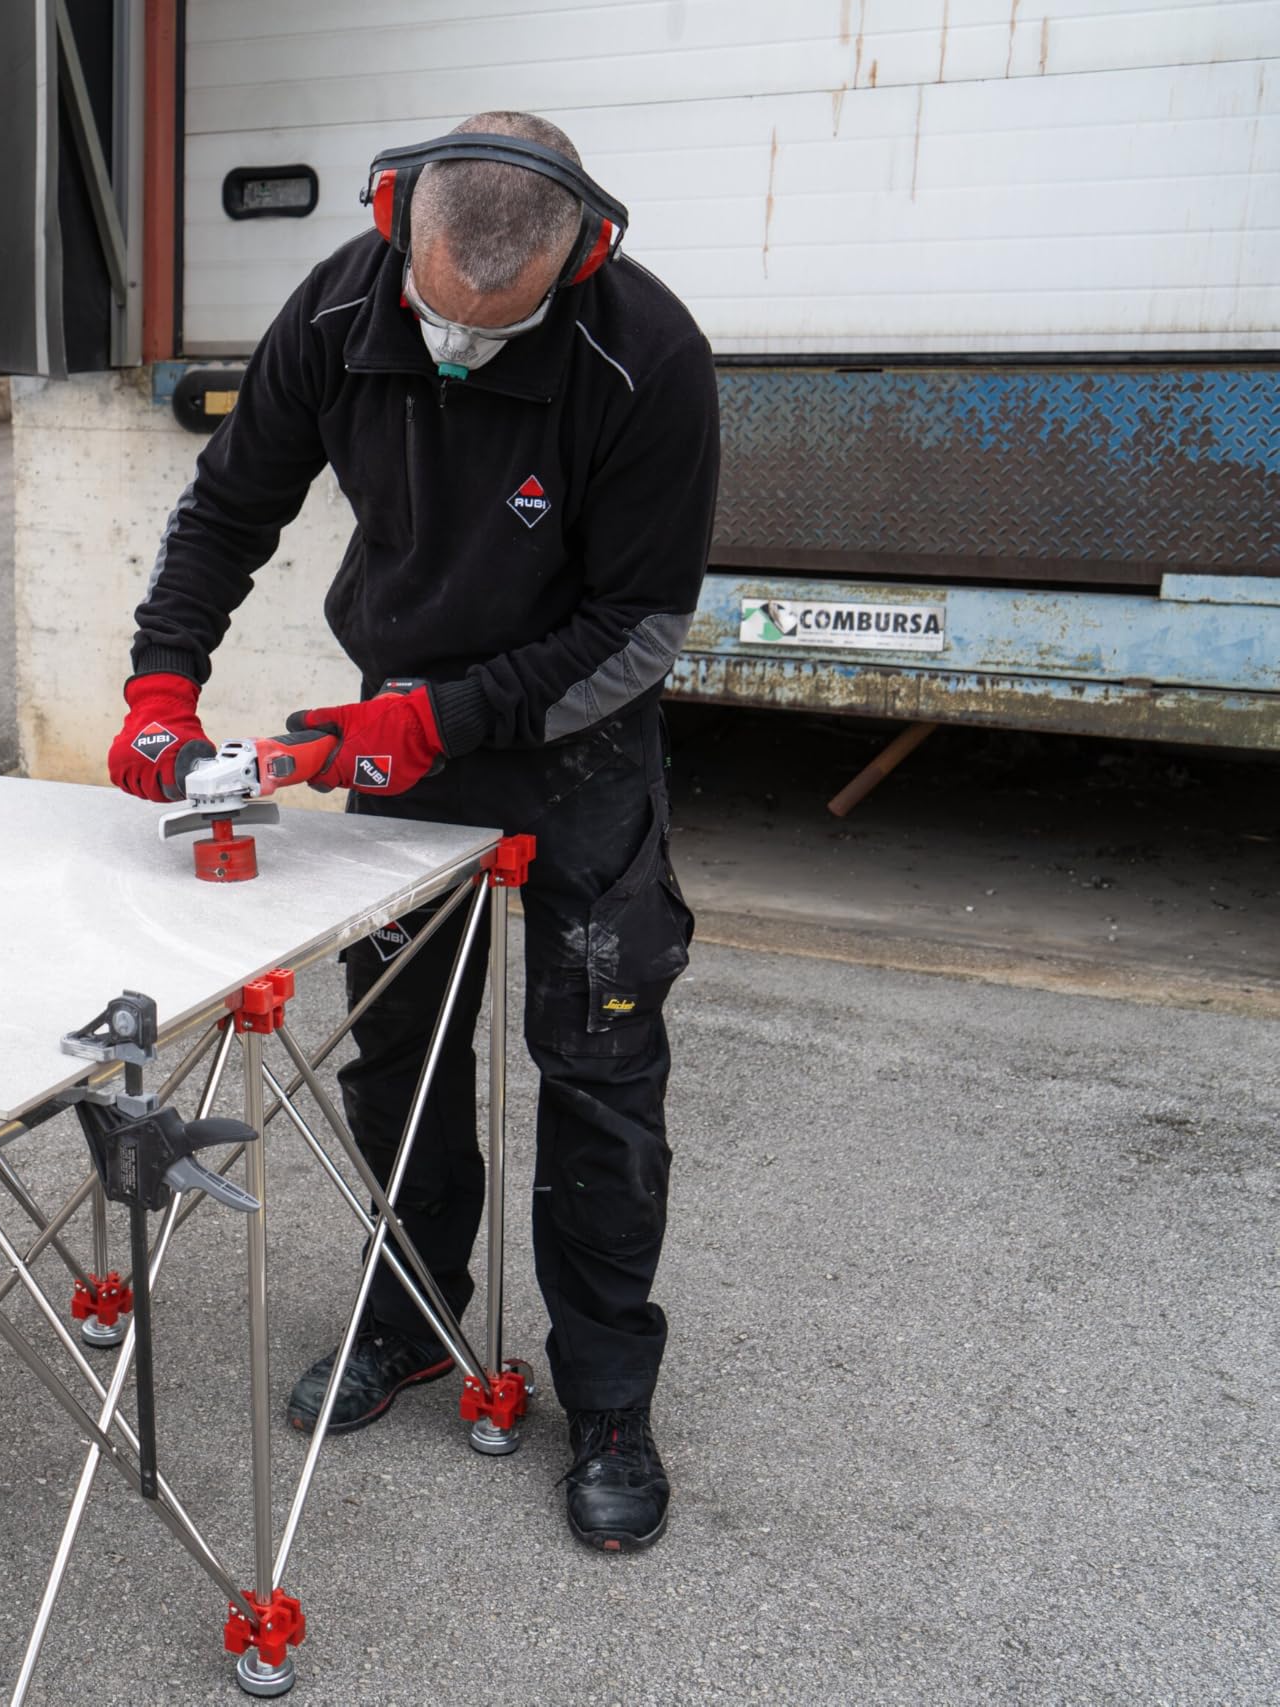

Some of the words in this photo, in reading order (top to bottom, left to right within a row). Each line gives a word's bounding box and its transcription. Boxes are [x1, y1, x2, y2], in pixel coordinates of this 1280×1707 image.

[514, 497, 546, 509] RUBI
[800, 609, 941, 634] COMBURSA
[138, 735, 170, 747] RUBI
[359, 759, 386, 785] RUBI
[373, 929, 404, 944] RUBI
